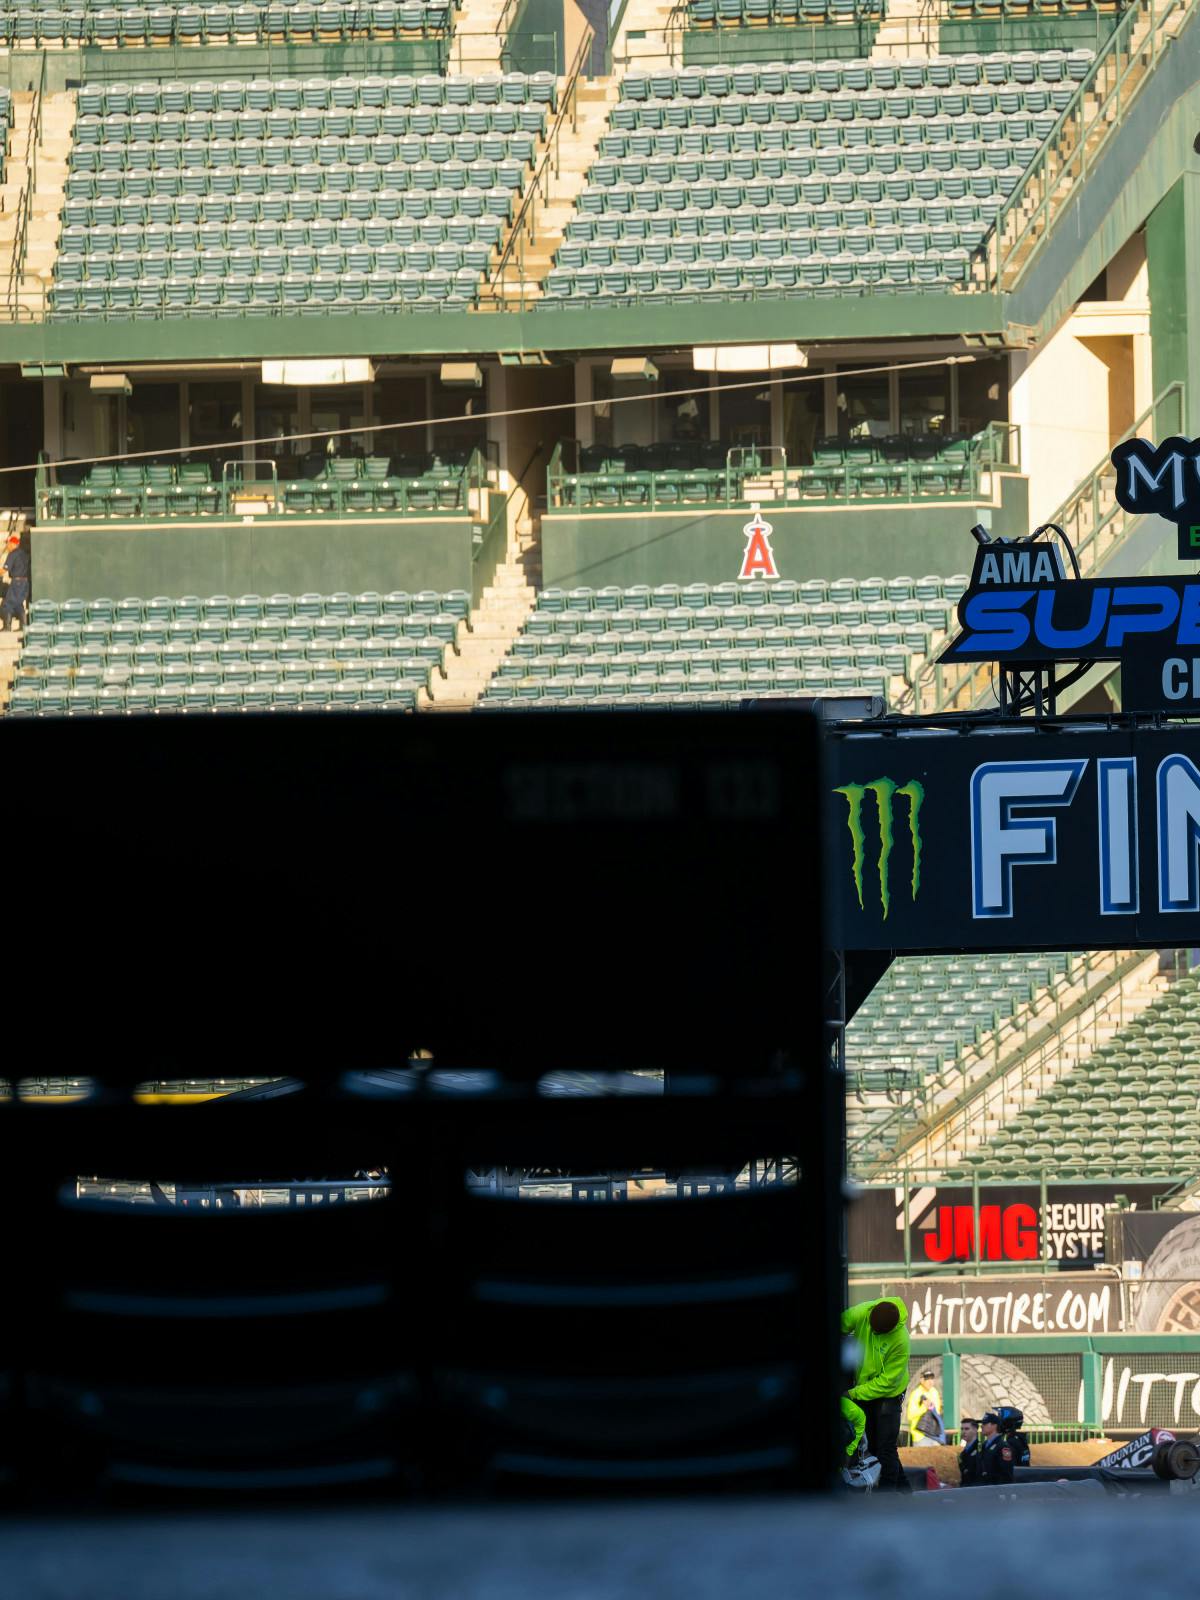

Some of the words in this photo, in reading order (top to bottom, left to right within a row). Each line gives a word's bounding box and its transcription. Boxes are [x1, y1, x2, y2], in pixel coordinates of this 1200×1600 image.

[979, 551, 1053, 585] AMA
[923, 1203, 1039, 1262] JMG
[1038, 1202, 1137, 1231] SECUR
[1038, 1231, 1105, 1260] SYSTE
[909, 1285, 1110, 1336] NITTOTIRE.COM
